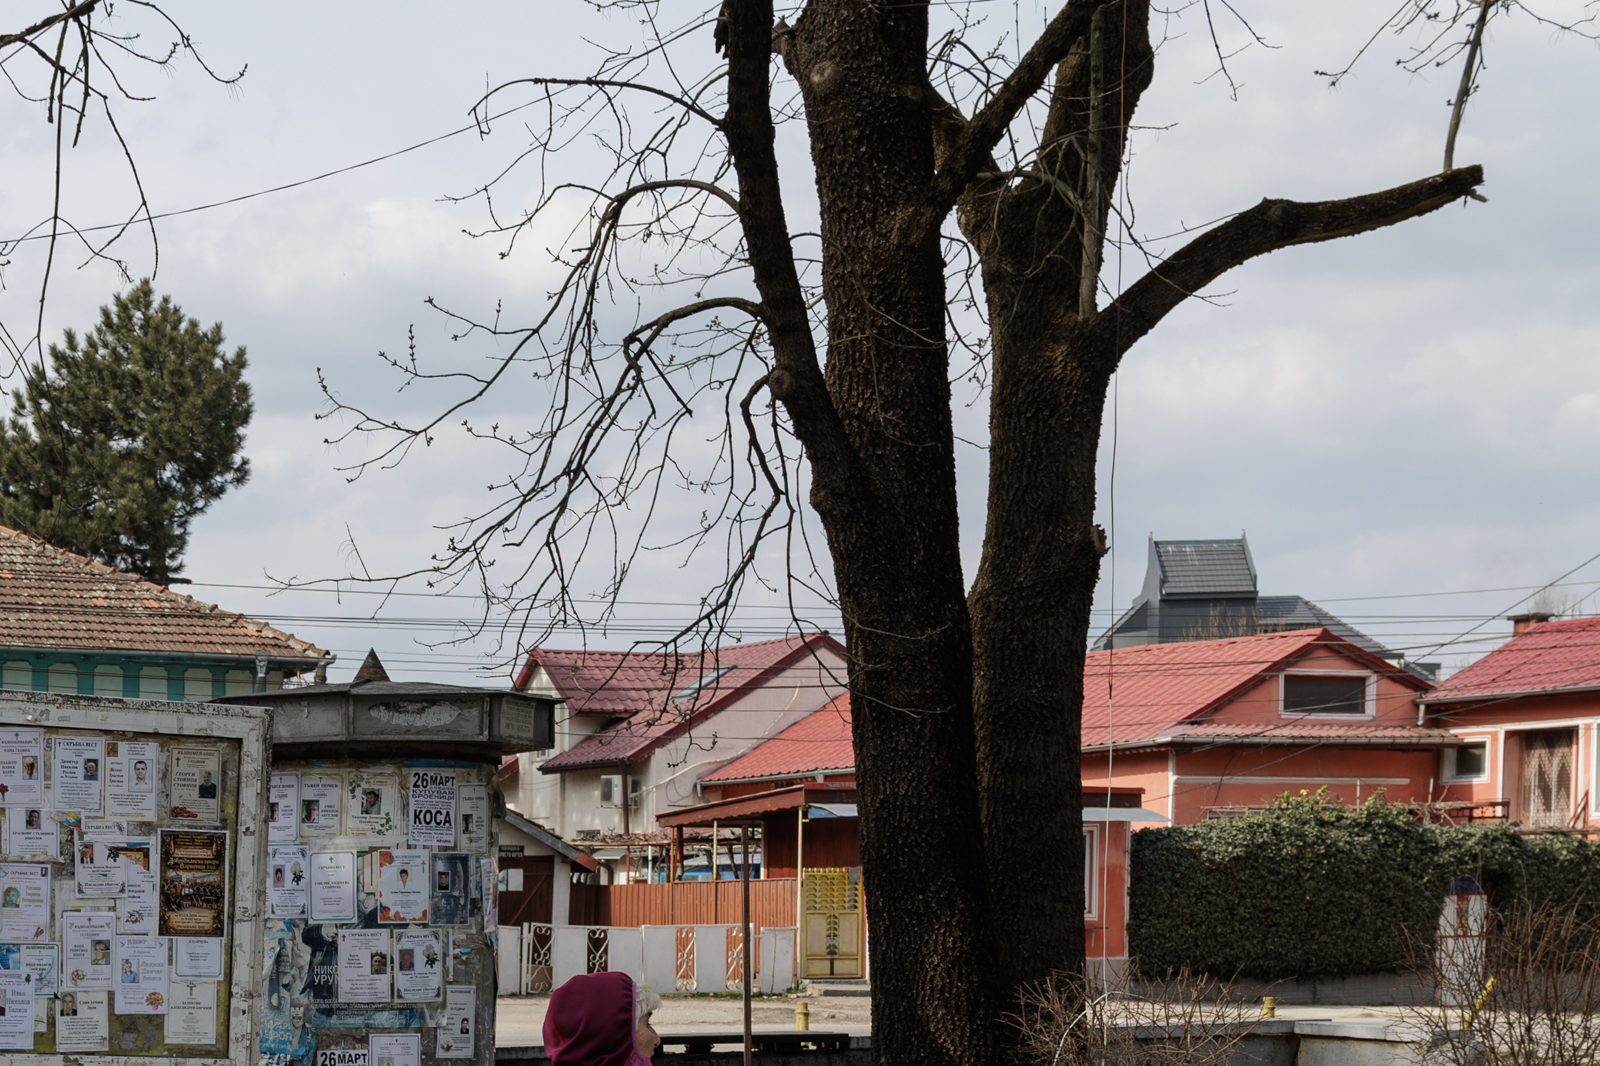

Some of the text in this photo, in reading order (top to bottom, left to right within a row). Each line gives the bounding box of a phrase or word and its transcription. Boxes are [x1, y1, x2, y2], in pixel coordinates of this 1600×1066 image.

[413, 772, 456, 788] 26 МАРТ
[413, 809, 452, 826] КОСА
[320, 1052, 367, 1066] 26 МАРТ
